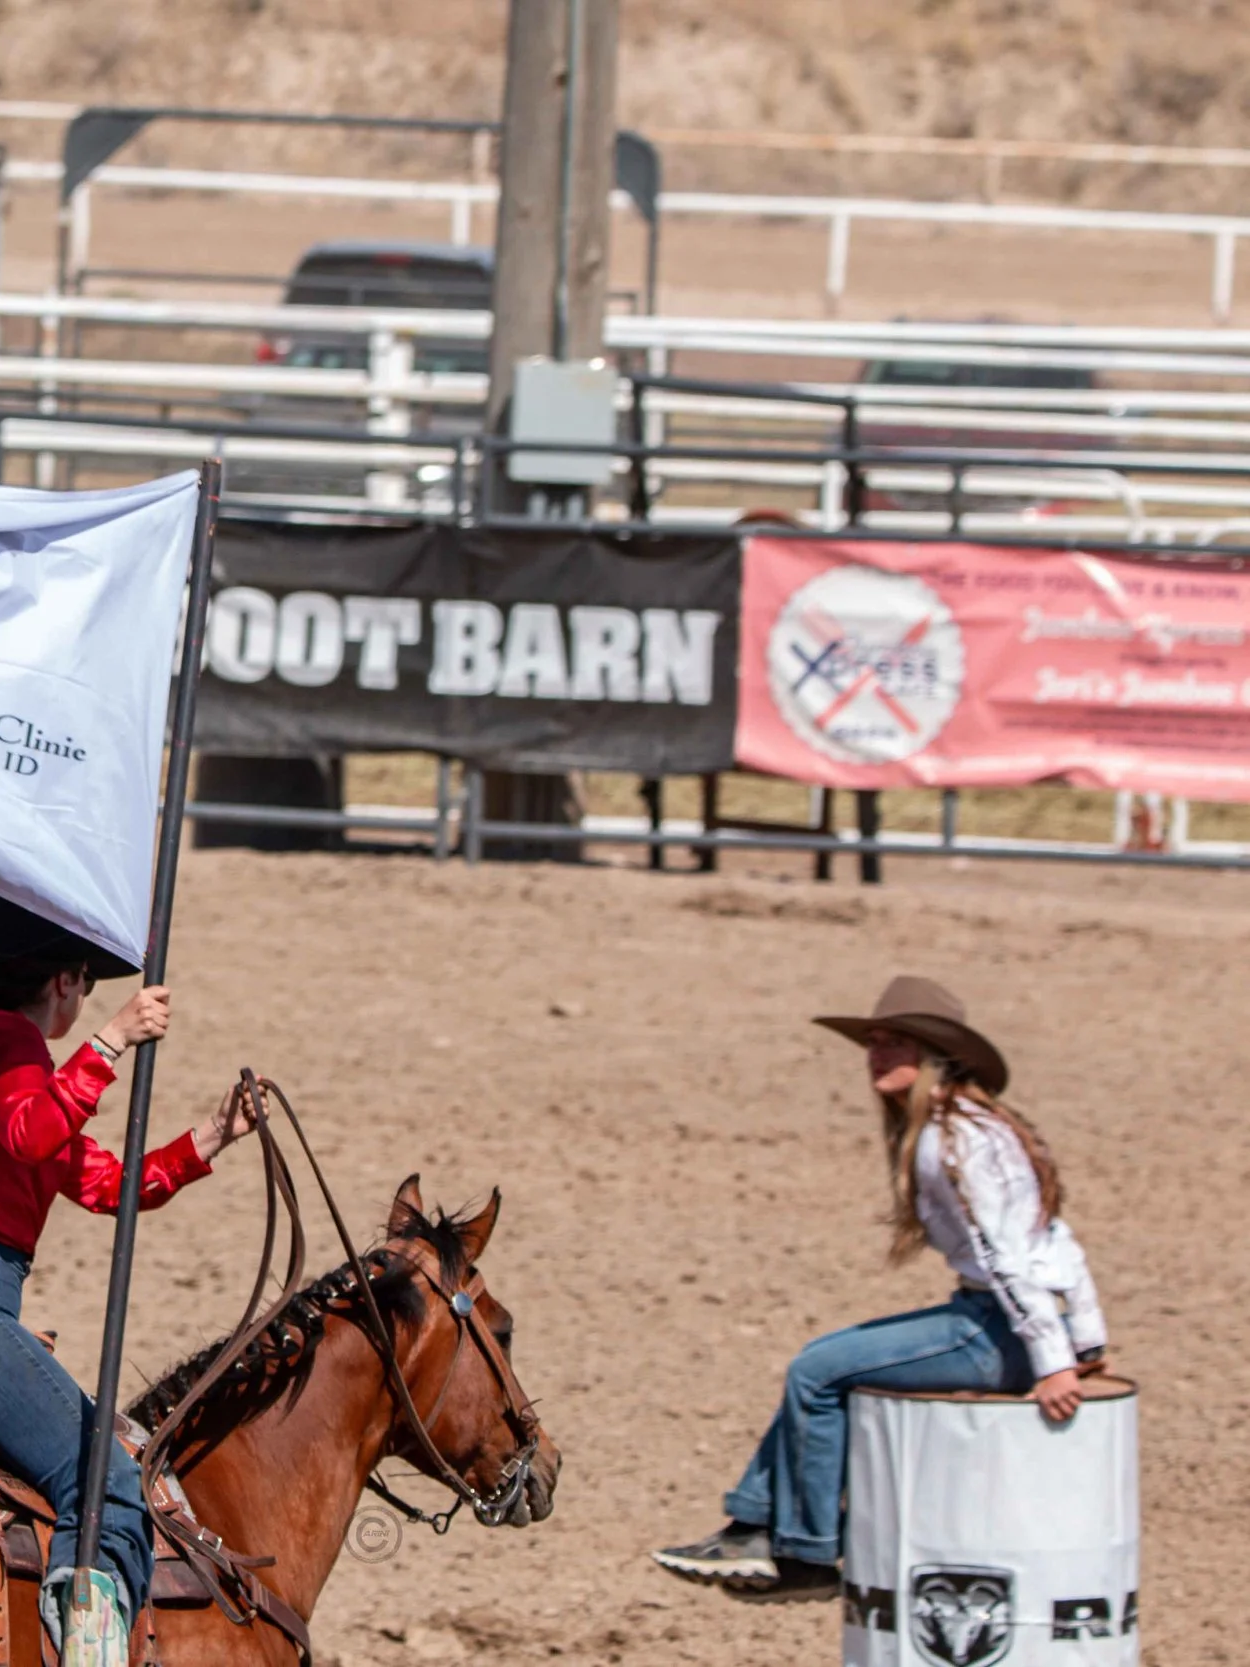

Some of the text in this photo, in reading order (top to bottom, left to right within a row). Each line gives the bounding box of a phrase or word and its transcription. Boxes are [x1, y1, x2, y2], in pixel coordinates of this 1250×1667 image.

[172, 586, 723, 705] OOT BARN
[3, 751, 39, 777] ID
